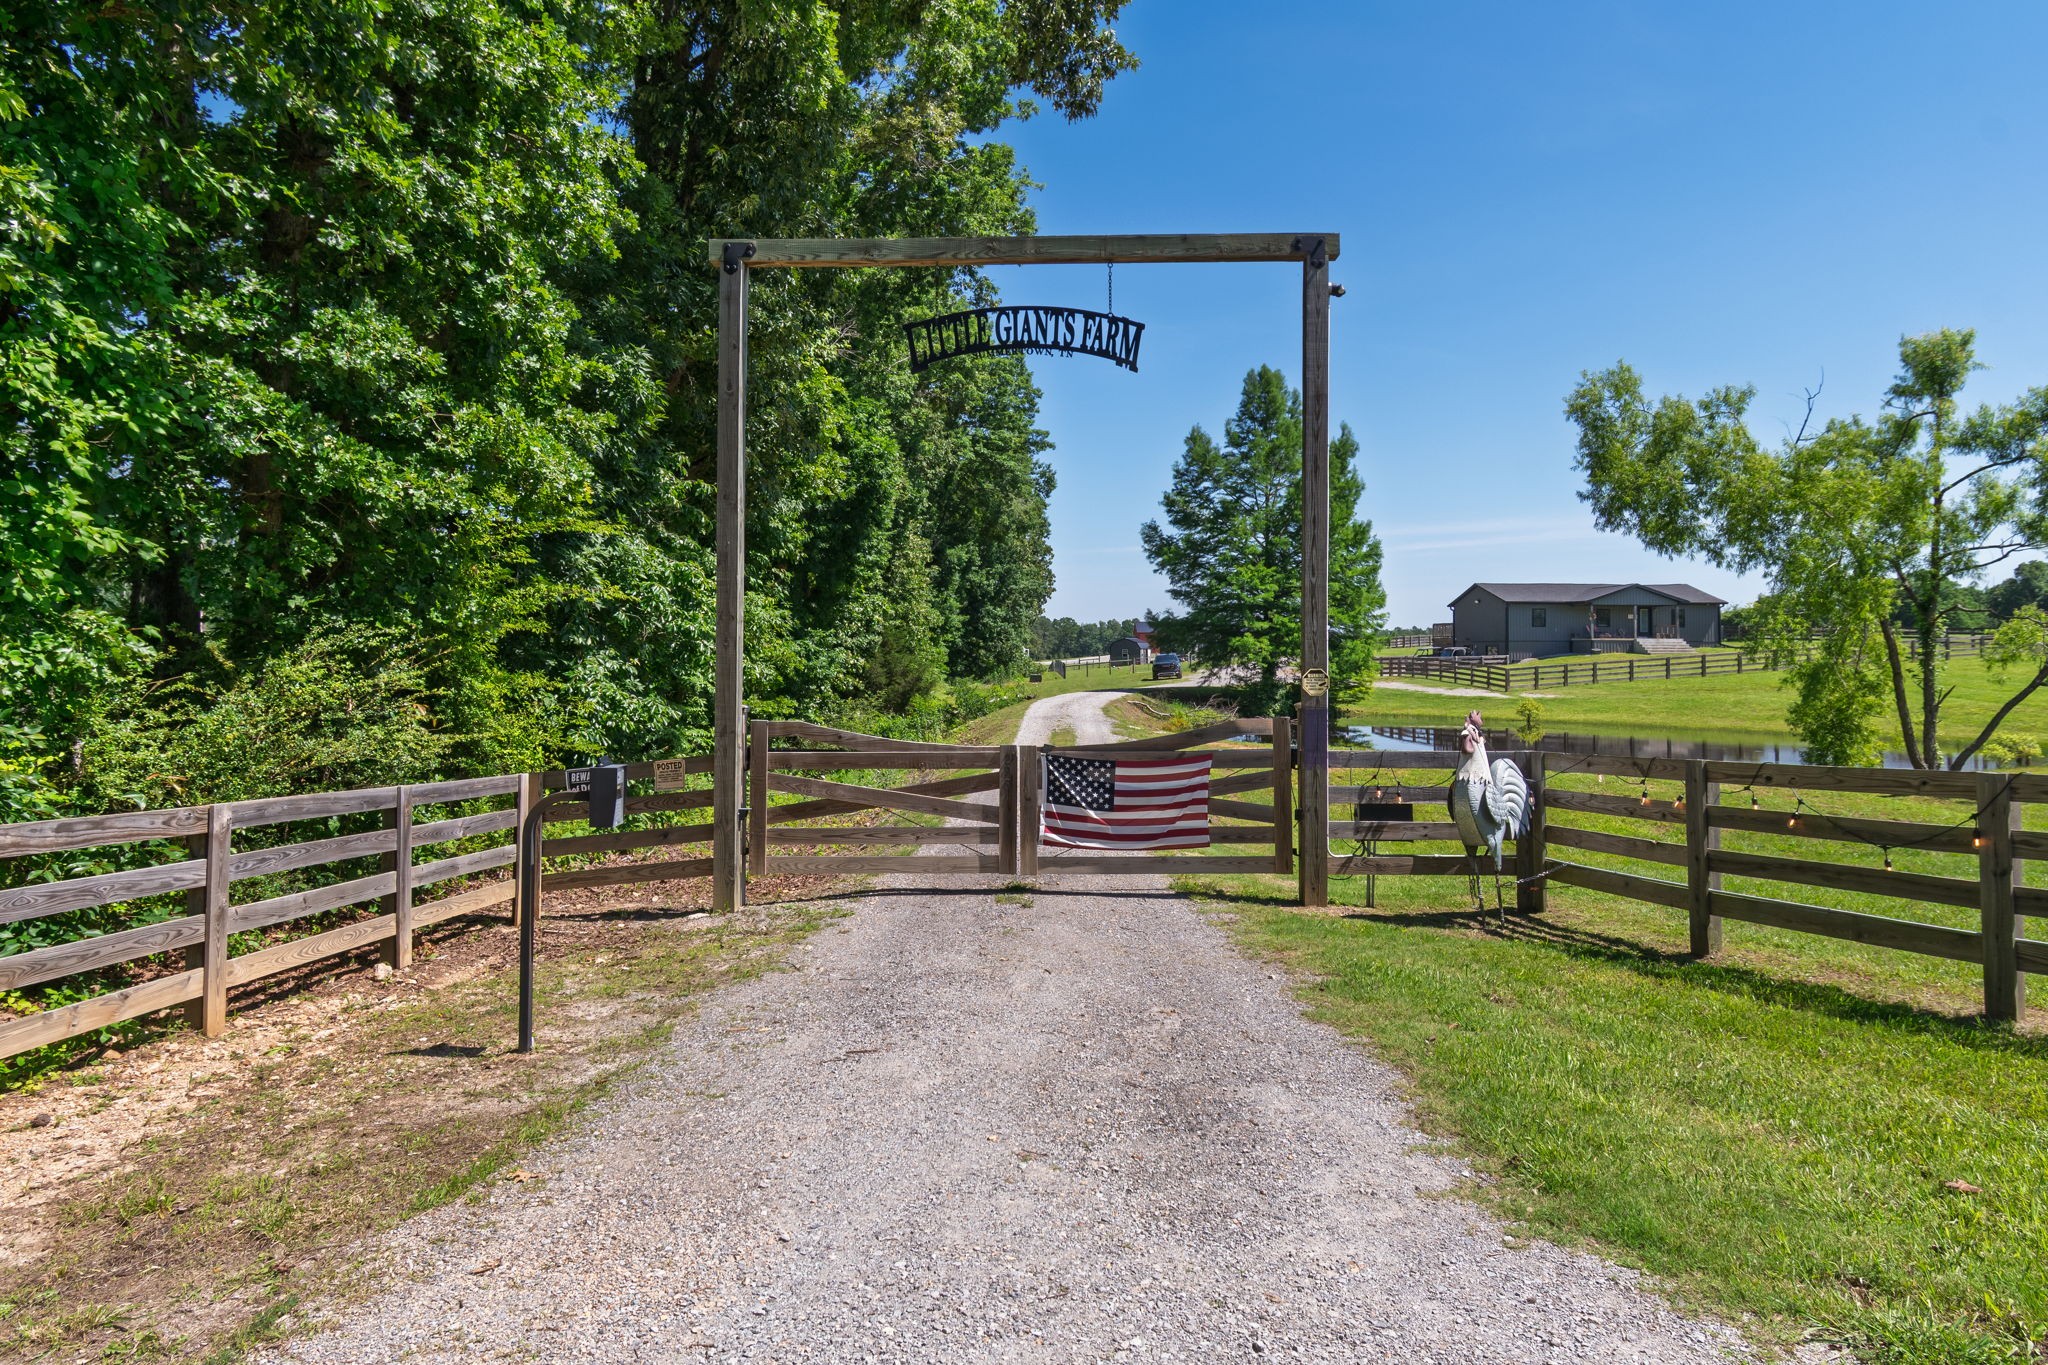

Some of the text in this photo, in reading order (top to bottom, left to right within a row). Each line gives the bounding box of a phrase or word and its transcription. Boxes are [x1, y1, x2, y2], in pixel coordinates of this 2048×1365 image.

[903, 306, 1145, 374] LITTLE GIANTS FARM
[1060, 349, 1074, 358] TN
[656, 761, 683, 771] POSTED
[571, 771, 590, 782] BEWA
